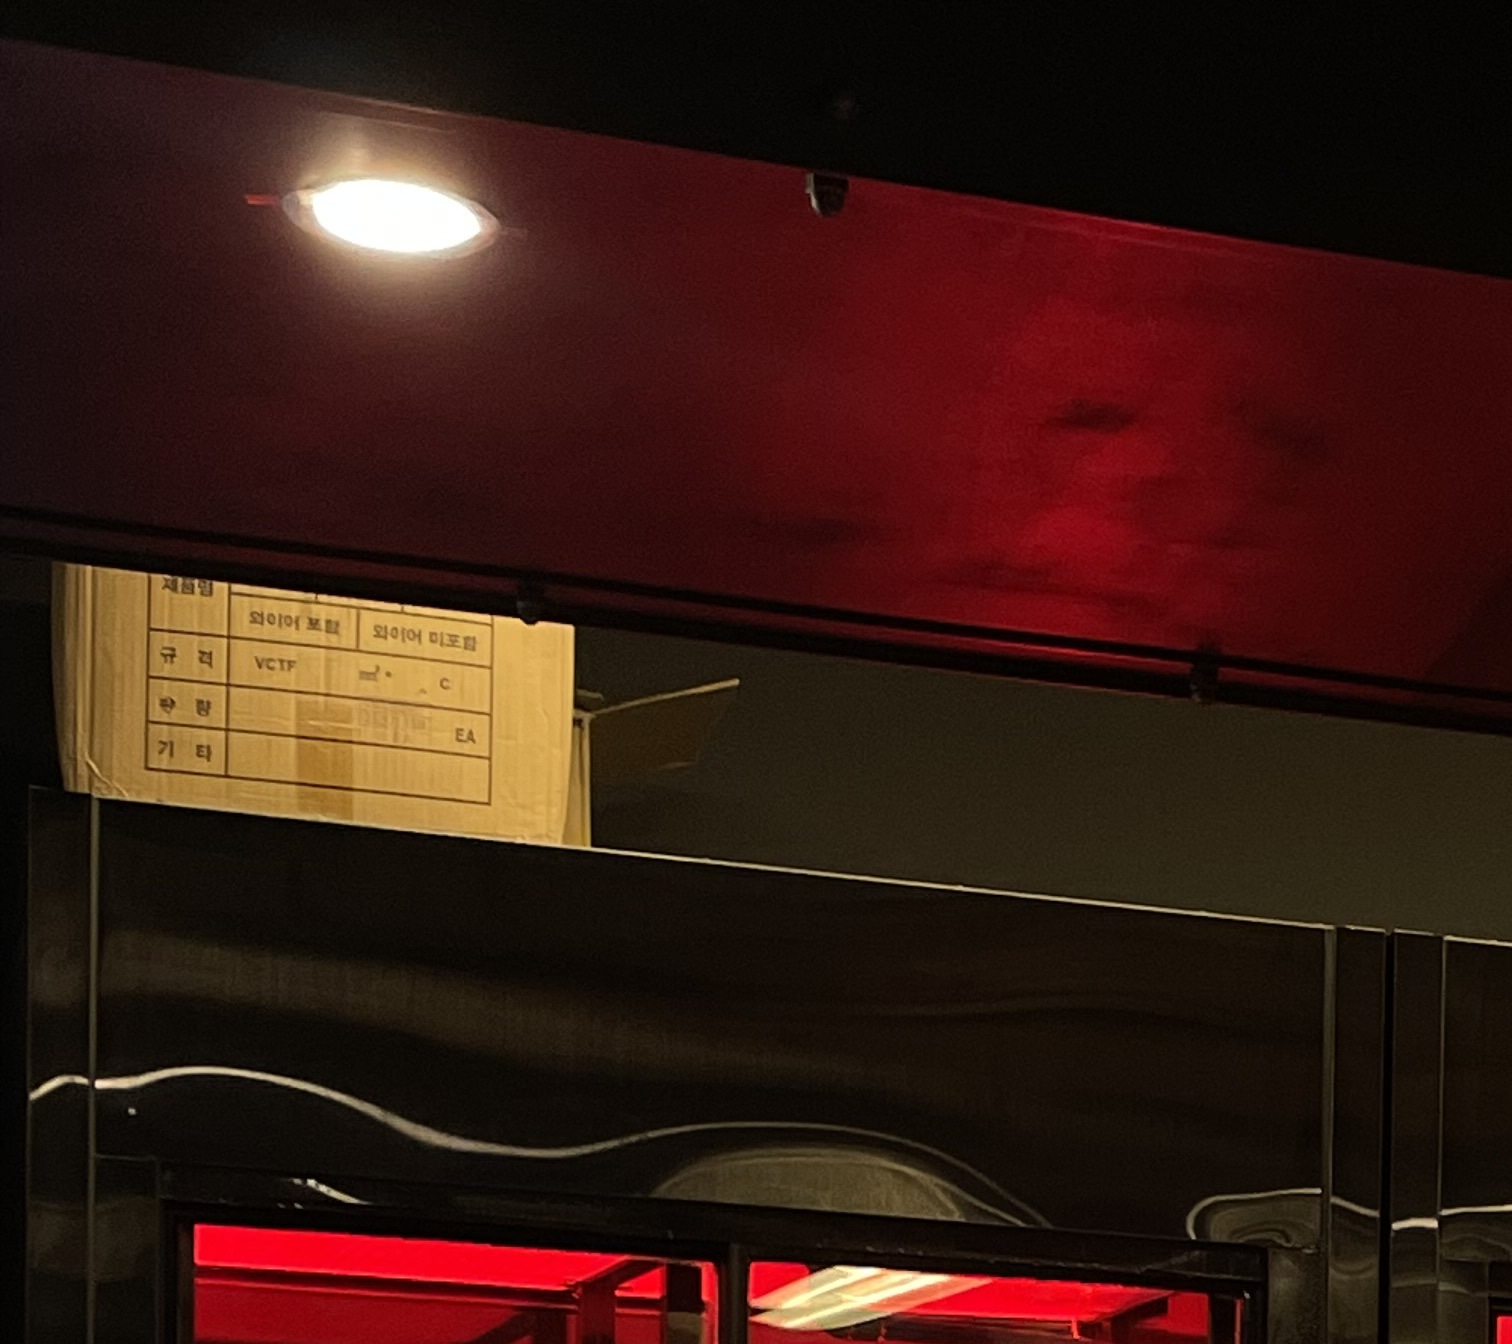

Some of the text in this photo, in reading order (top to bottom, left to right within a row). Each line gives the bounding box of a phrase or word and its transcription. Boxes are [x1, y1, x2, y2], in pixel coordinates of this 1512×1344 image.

[249, 610, 341, 636] 와이어 포함
[373, 623, 478, 652] 와이어 미포함
[254, 655, 297, 673] VCTF
[455, 728, 477, 745] EA
